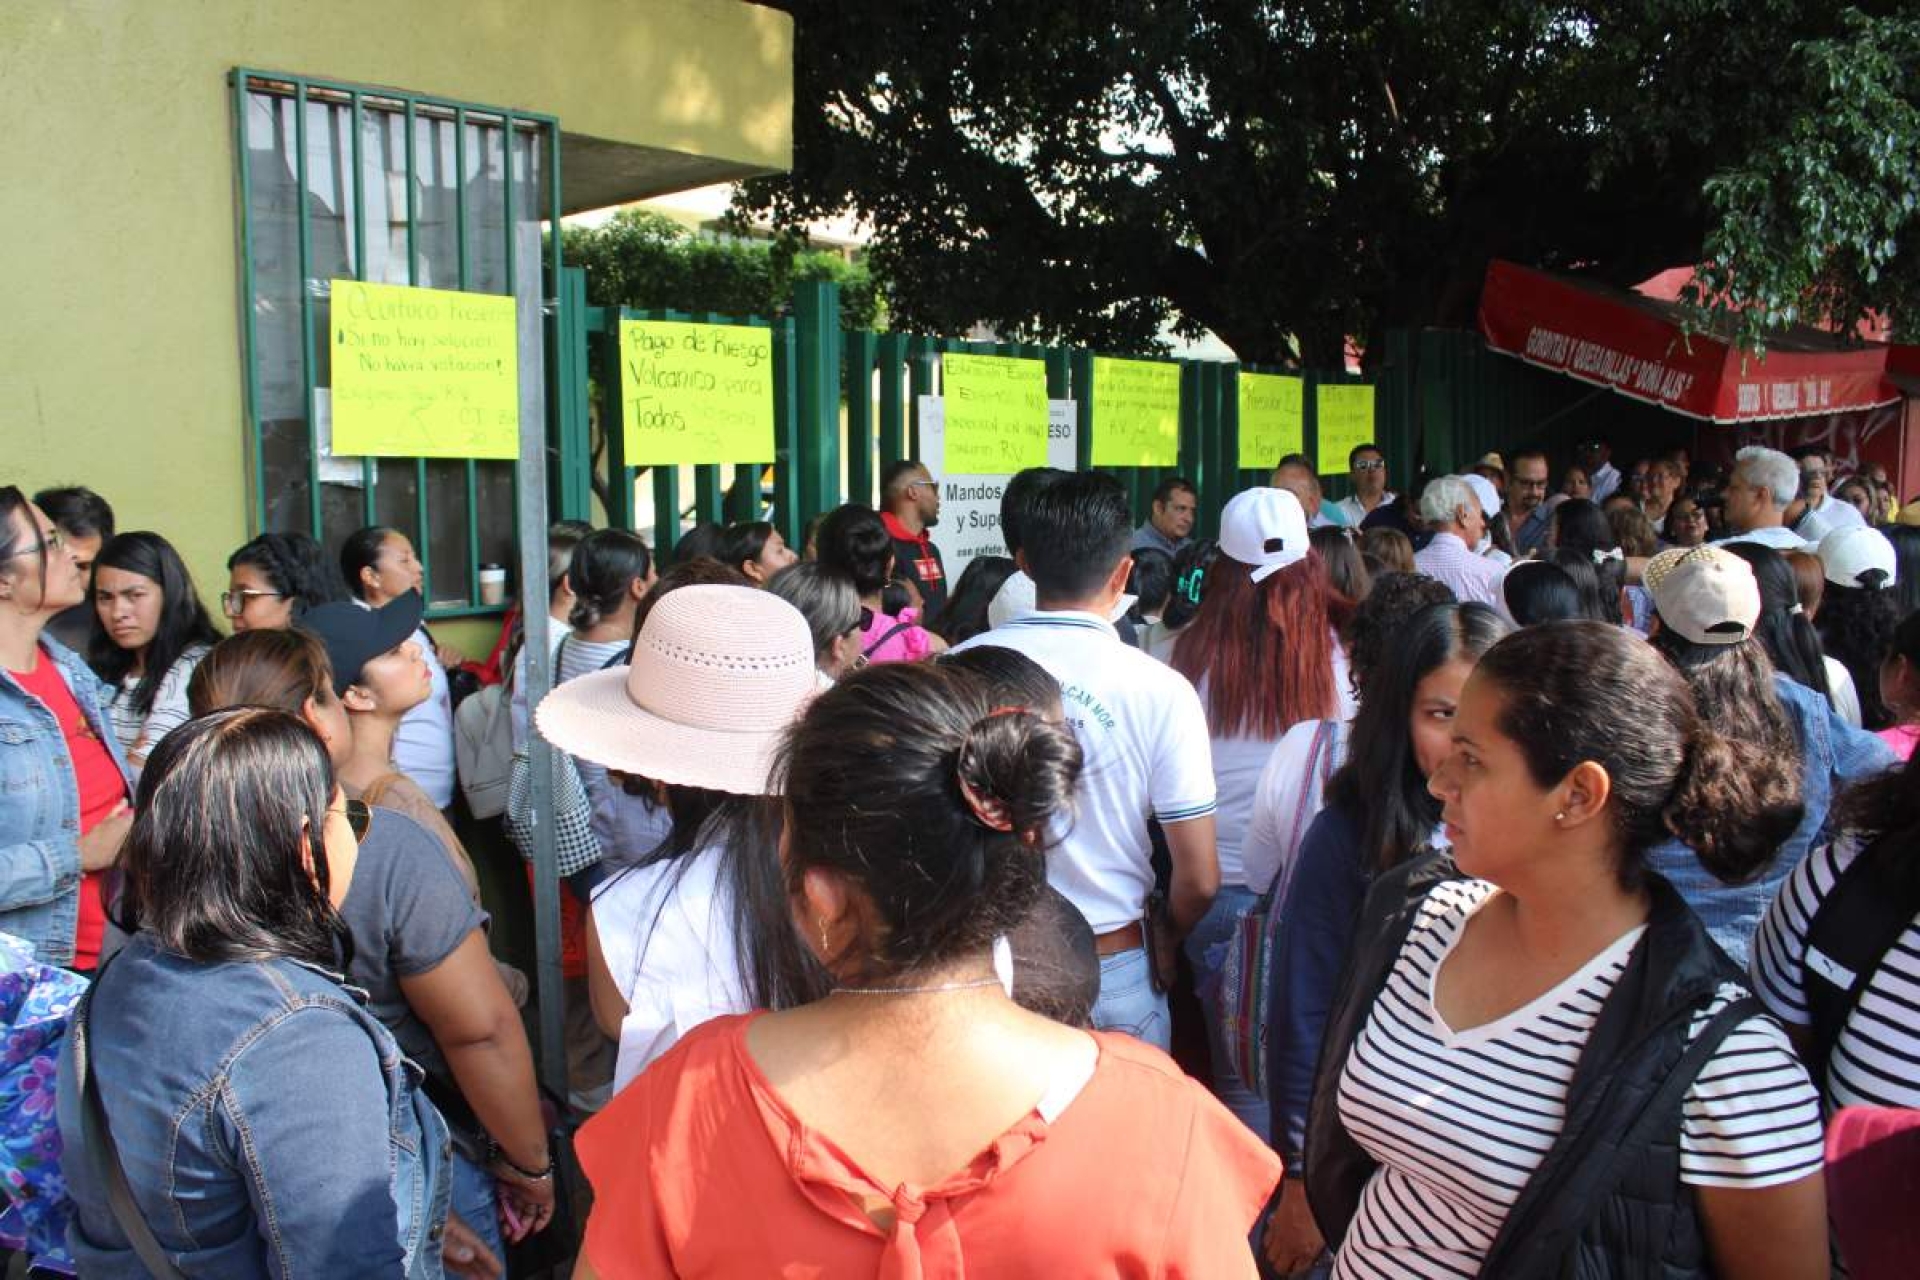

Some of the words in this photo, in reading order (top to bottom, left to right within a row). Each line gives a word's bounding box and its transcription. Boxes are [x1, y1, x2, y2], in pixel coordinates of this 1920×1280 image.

[629, 327, 677, 359] Pago
[683, 328, 707, 354] de
[711, 330, 768, 368] Riesgo
[627, 396, 687, 431] Todos
[946, 482, 1002, 501] Mandos
[956, 514, 966, 534] y
